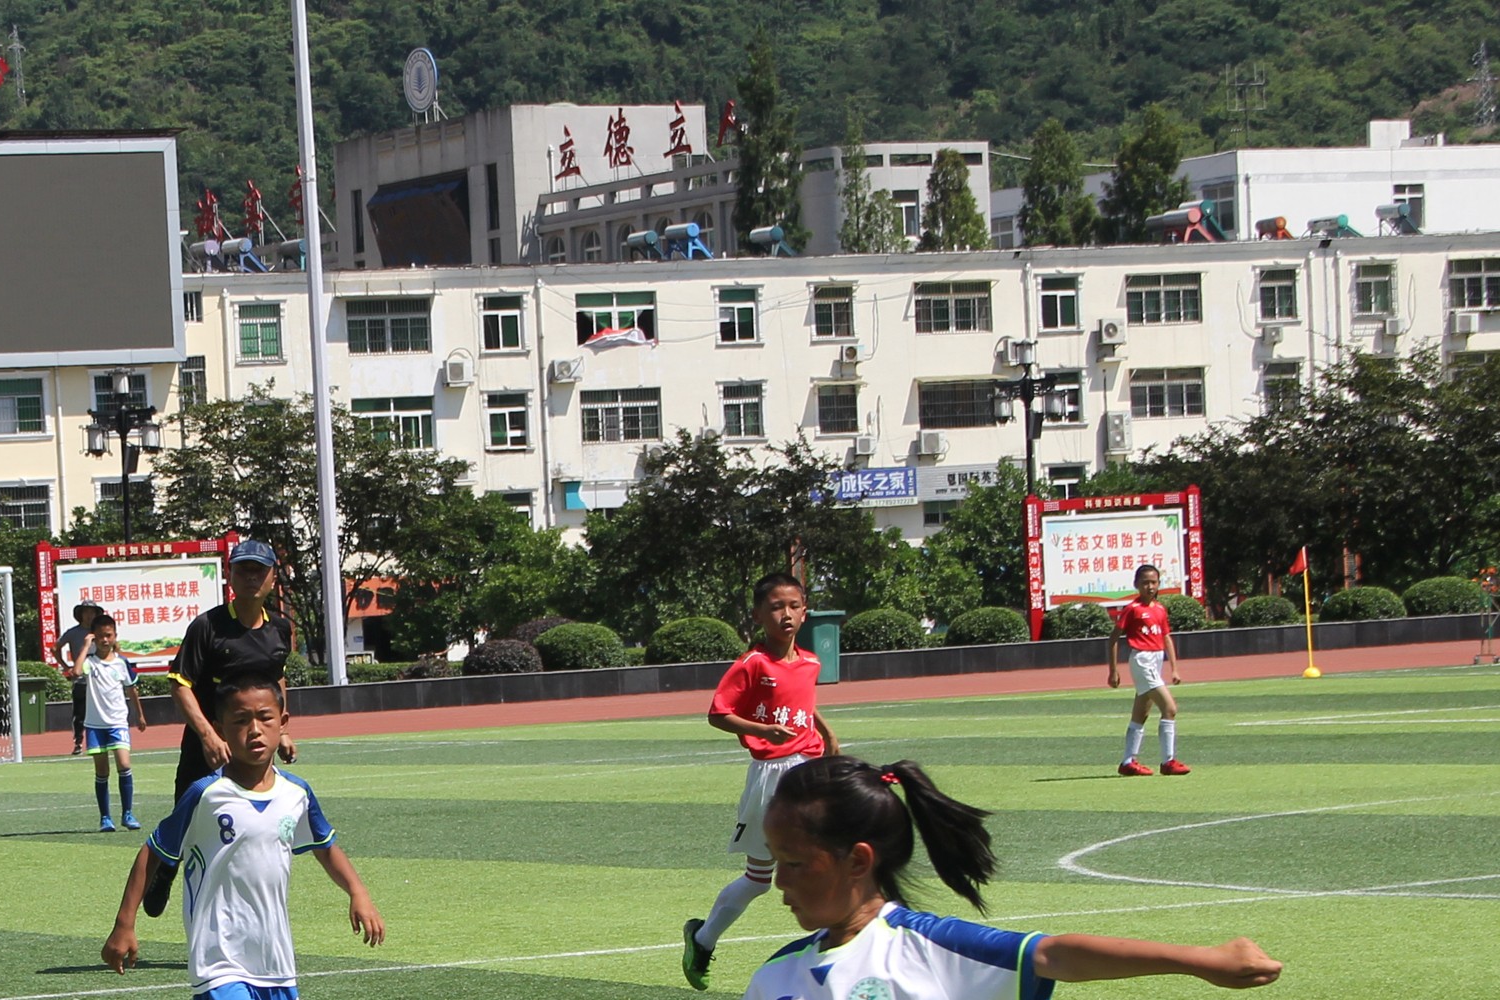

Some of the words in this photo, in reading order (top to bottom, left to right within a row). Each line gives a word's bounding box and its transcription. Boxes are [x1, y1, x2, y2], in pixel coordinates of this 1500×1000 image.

[841, 472, 905, 492] 成长之家
[106, 543, 173, 556] 科普知识画廊
[1062, 531, 1164, 552] 生态文明始于心
[1062, 553, 1164, 575] 环保创模践于行
[79, 580, 200, 602] 巩固国家园林县城成果
[104, 604, 199, 626] 中国最美乡村
[217, 813, 236, 845] 8
[733, 822, 747, 843] 7
